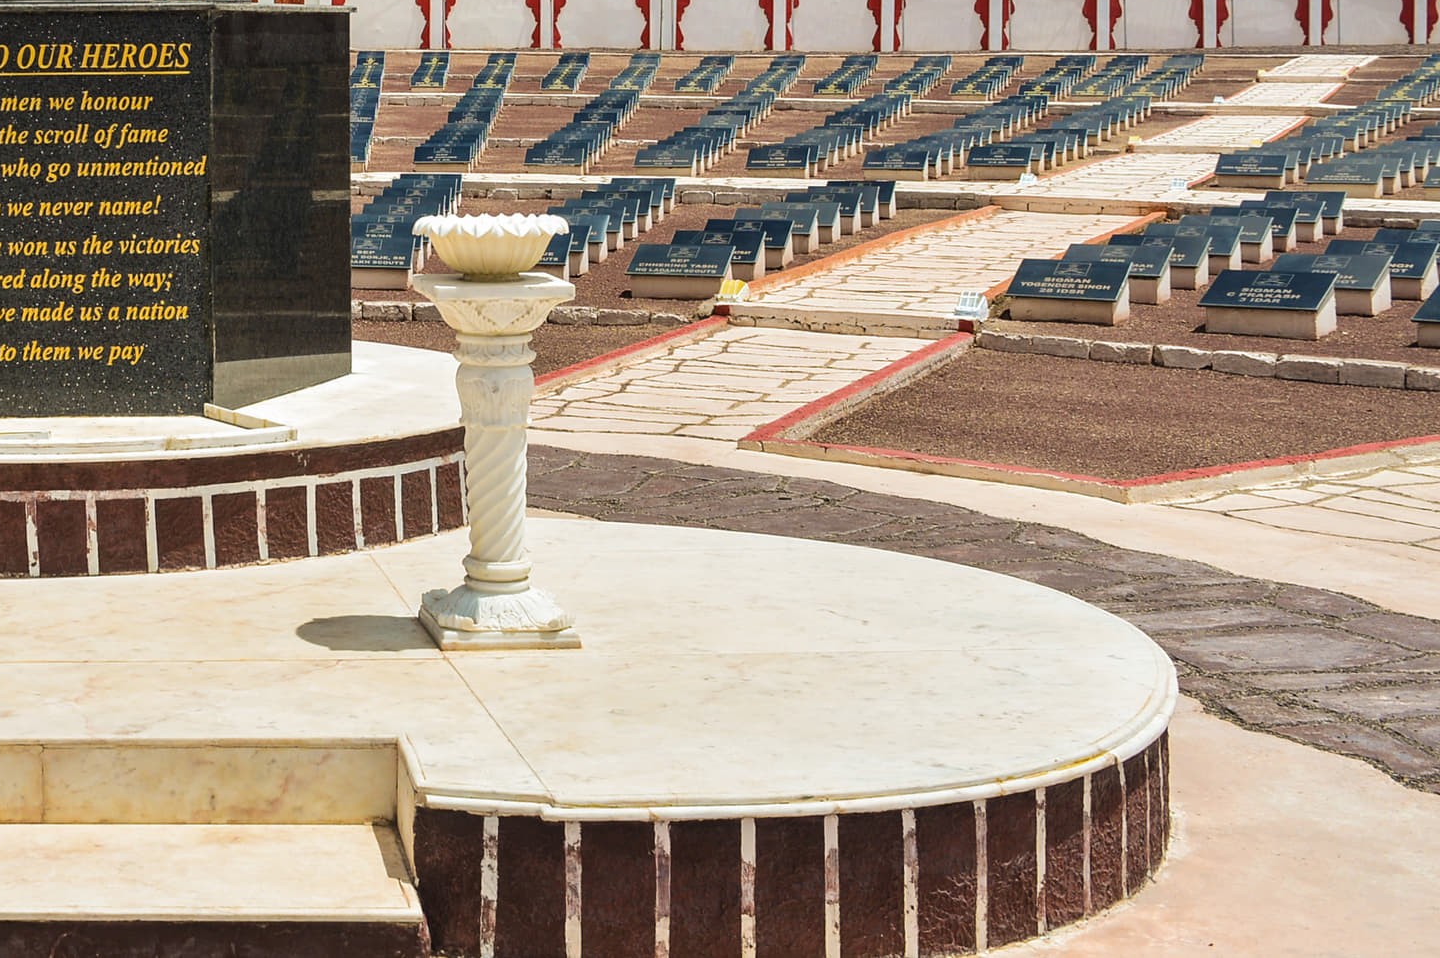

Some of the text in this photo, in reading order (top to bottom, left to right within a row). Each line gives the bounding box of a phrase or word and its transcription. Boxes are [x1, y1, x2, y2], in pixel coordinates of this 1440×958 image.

[17, 44, 73, 70] OUR
[80, 43, 191, 69] HEROES
[1, 97, 41, 112] men
[49, 97, 75, 111] we
[81, 91, 153, 111] honour
[34, 124, 89, 144] scroll
[94, 123, 117, 149] of
[116, 123, 168, 149] fame
[1, 158, 41, 178] who
[46, 163, 71, 183] go
[77, 155, 207, 177] unmentioned
[8, 202, 33, 217] we
[39, 202, 93, 217] never
[99, 195, 161, 216] name!
[8, 242, 48, 256] won
[55, 241, 77, 255] us
[83, 235, 113, 255] the
[119, 234, 200, 254] victories
[30, 268, 86, 294] along
[91, 268, 122, 288] the
[128, 272, 173, 294] way;
[21, 301, 74, 322] made
[80, 307, 103, 322] us
[108, 306, 120, 321] a
[126, 300, 189, 321] nation
[23, 340, 71, 361] them
[78, 346, 104, 360] we
[107, 345, 145, 367] pay
